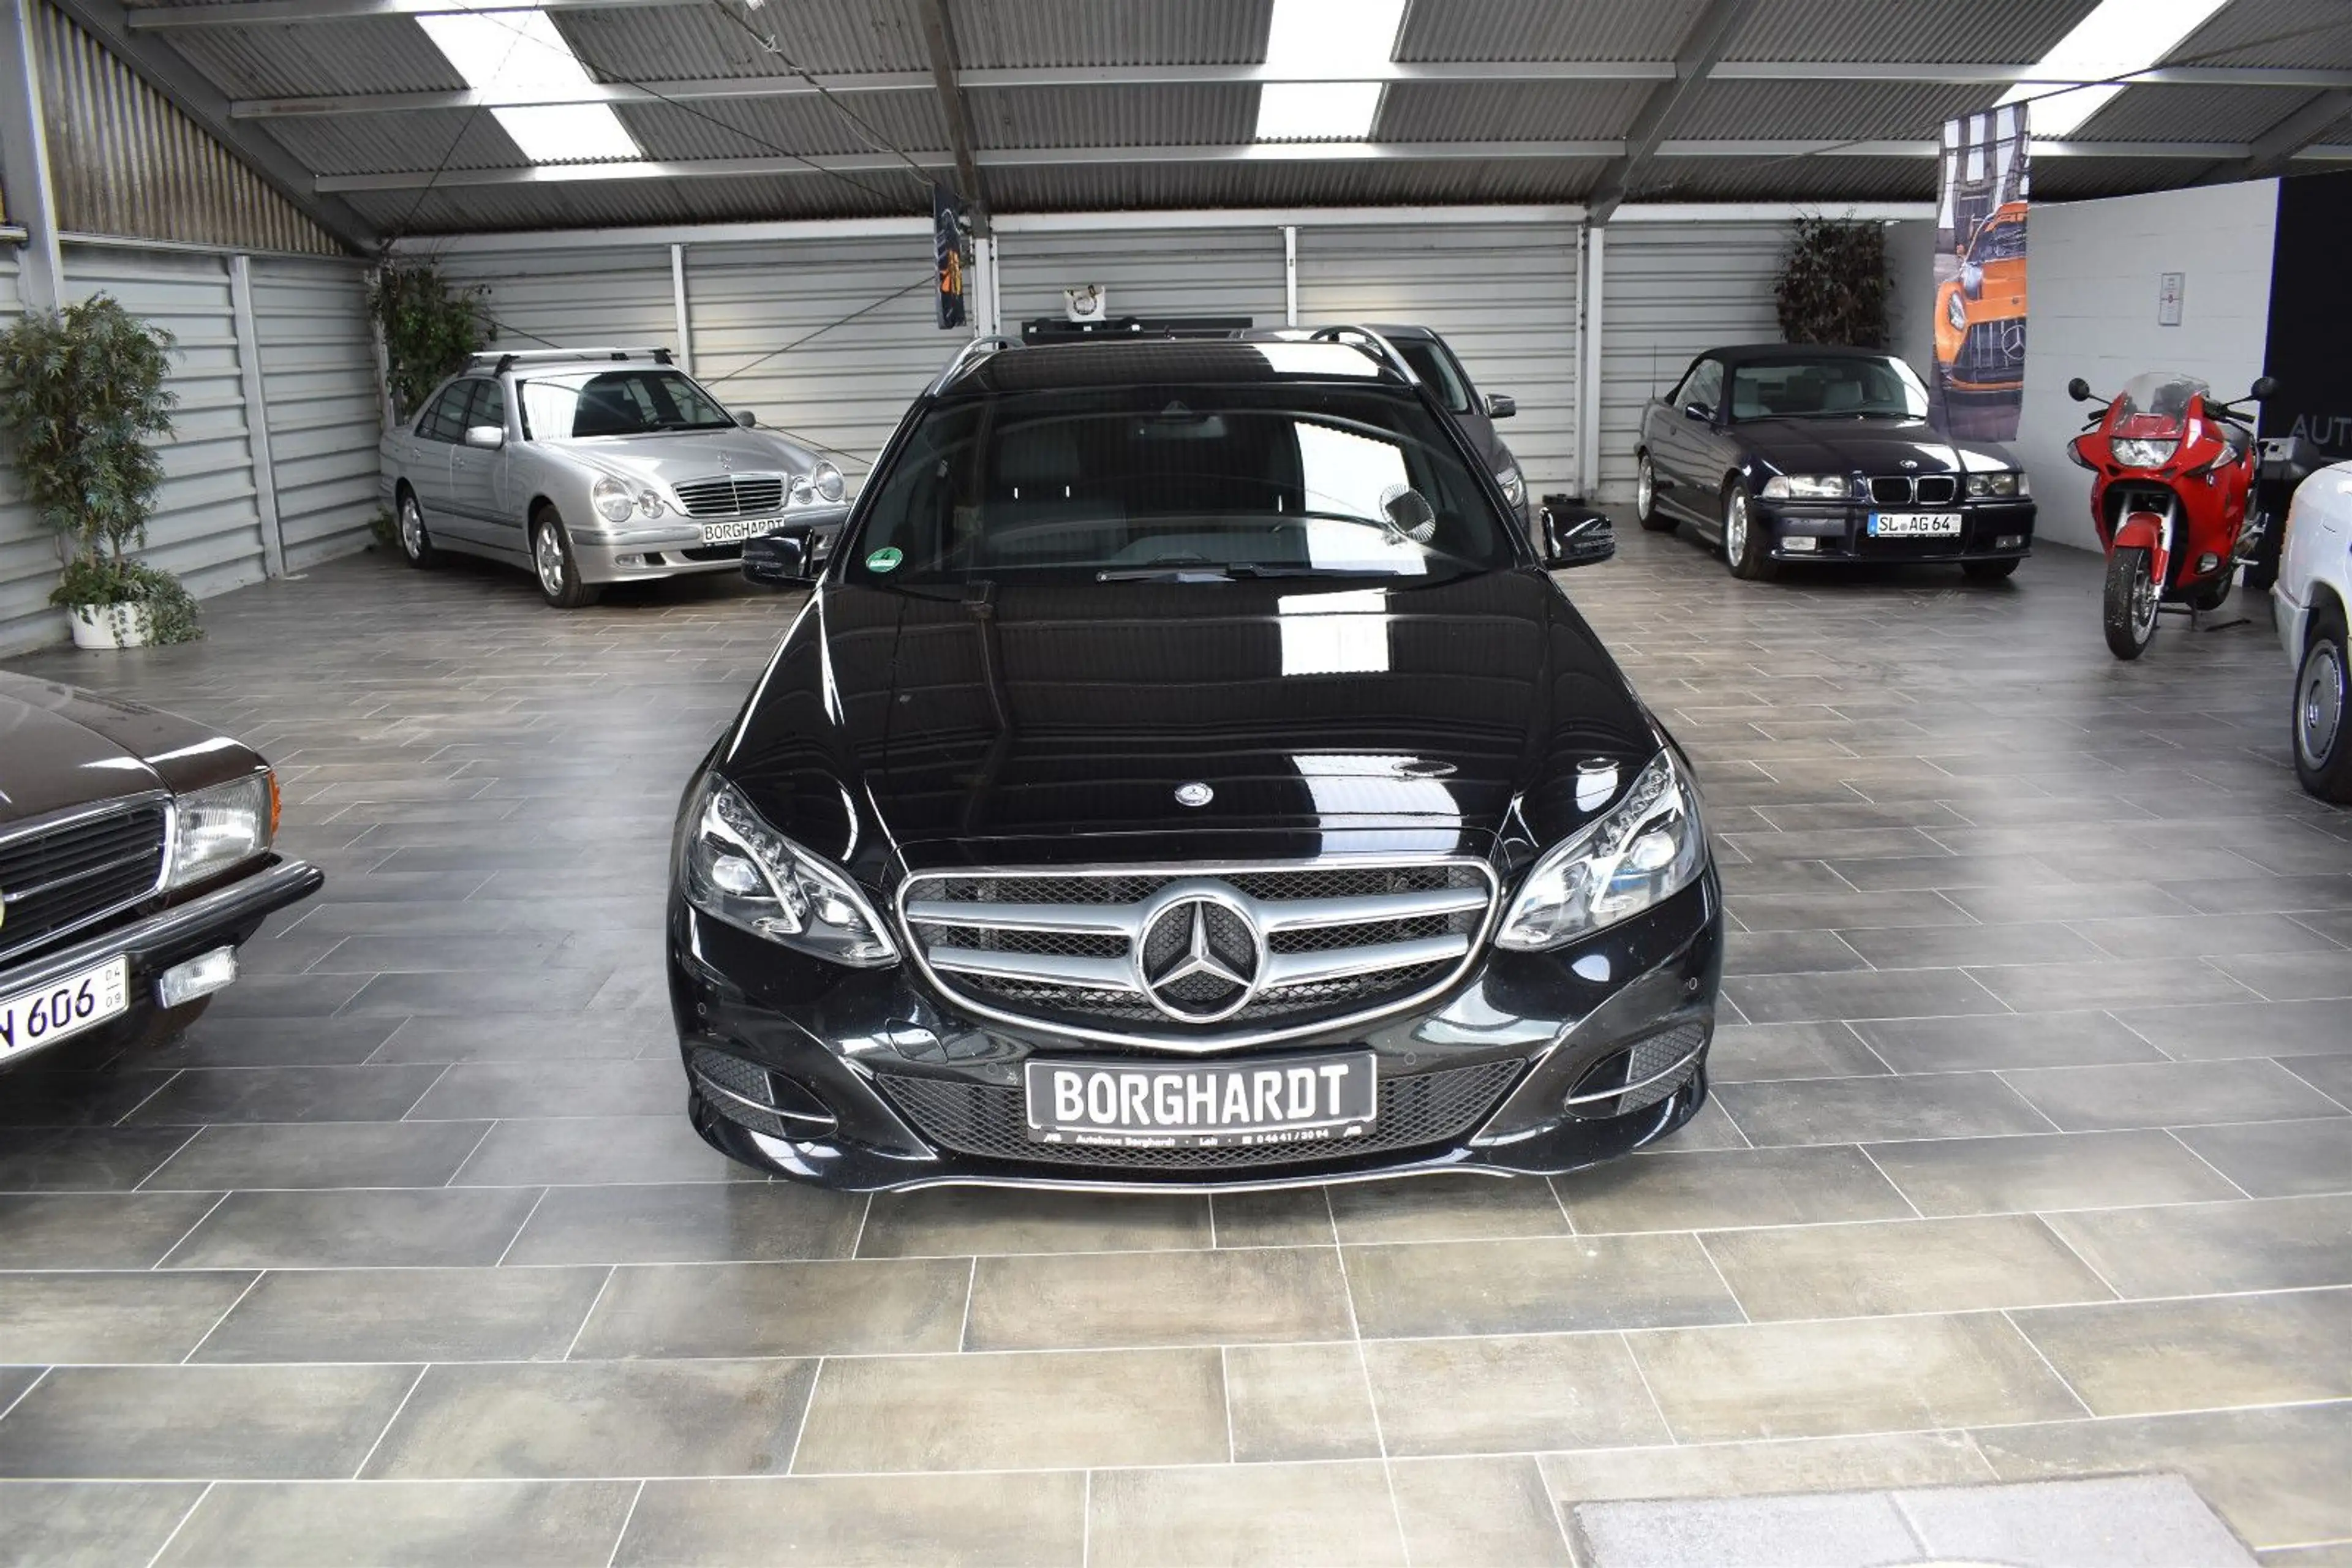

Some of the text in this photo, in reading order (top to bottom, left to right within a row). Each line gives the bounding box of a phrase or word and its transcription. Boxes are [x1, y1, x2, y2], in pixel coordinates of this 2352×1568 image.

[2289, 413, 2352, 447] AUT
[1879, 517, 1898, 531] SL
[1909, 517, 1928, 531] AG
[1932, 517, 1950, 531] 64
[28, 978, 95, 1037] 606
[1054, 1065, 1349, 1125] BORGHARDT
